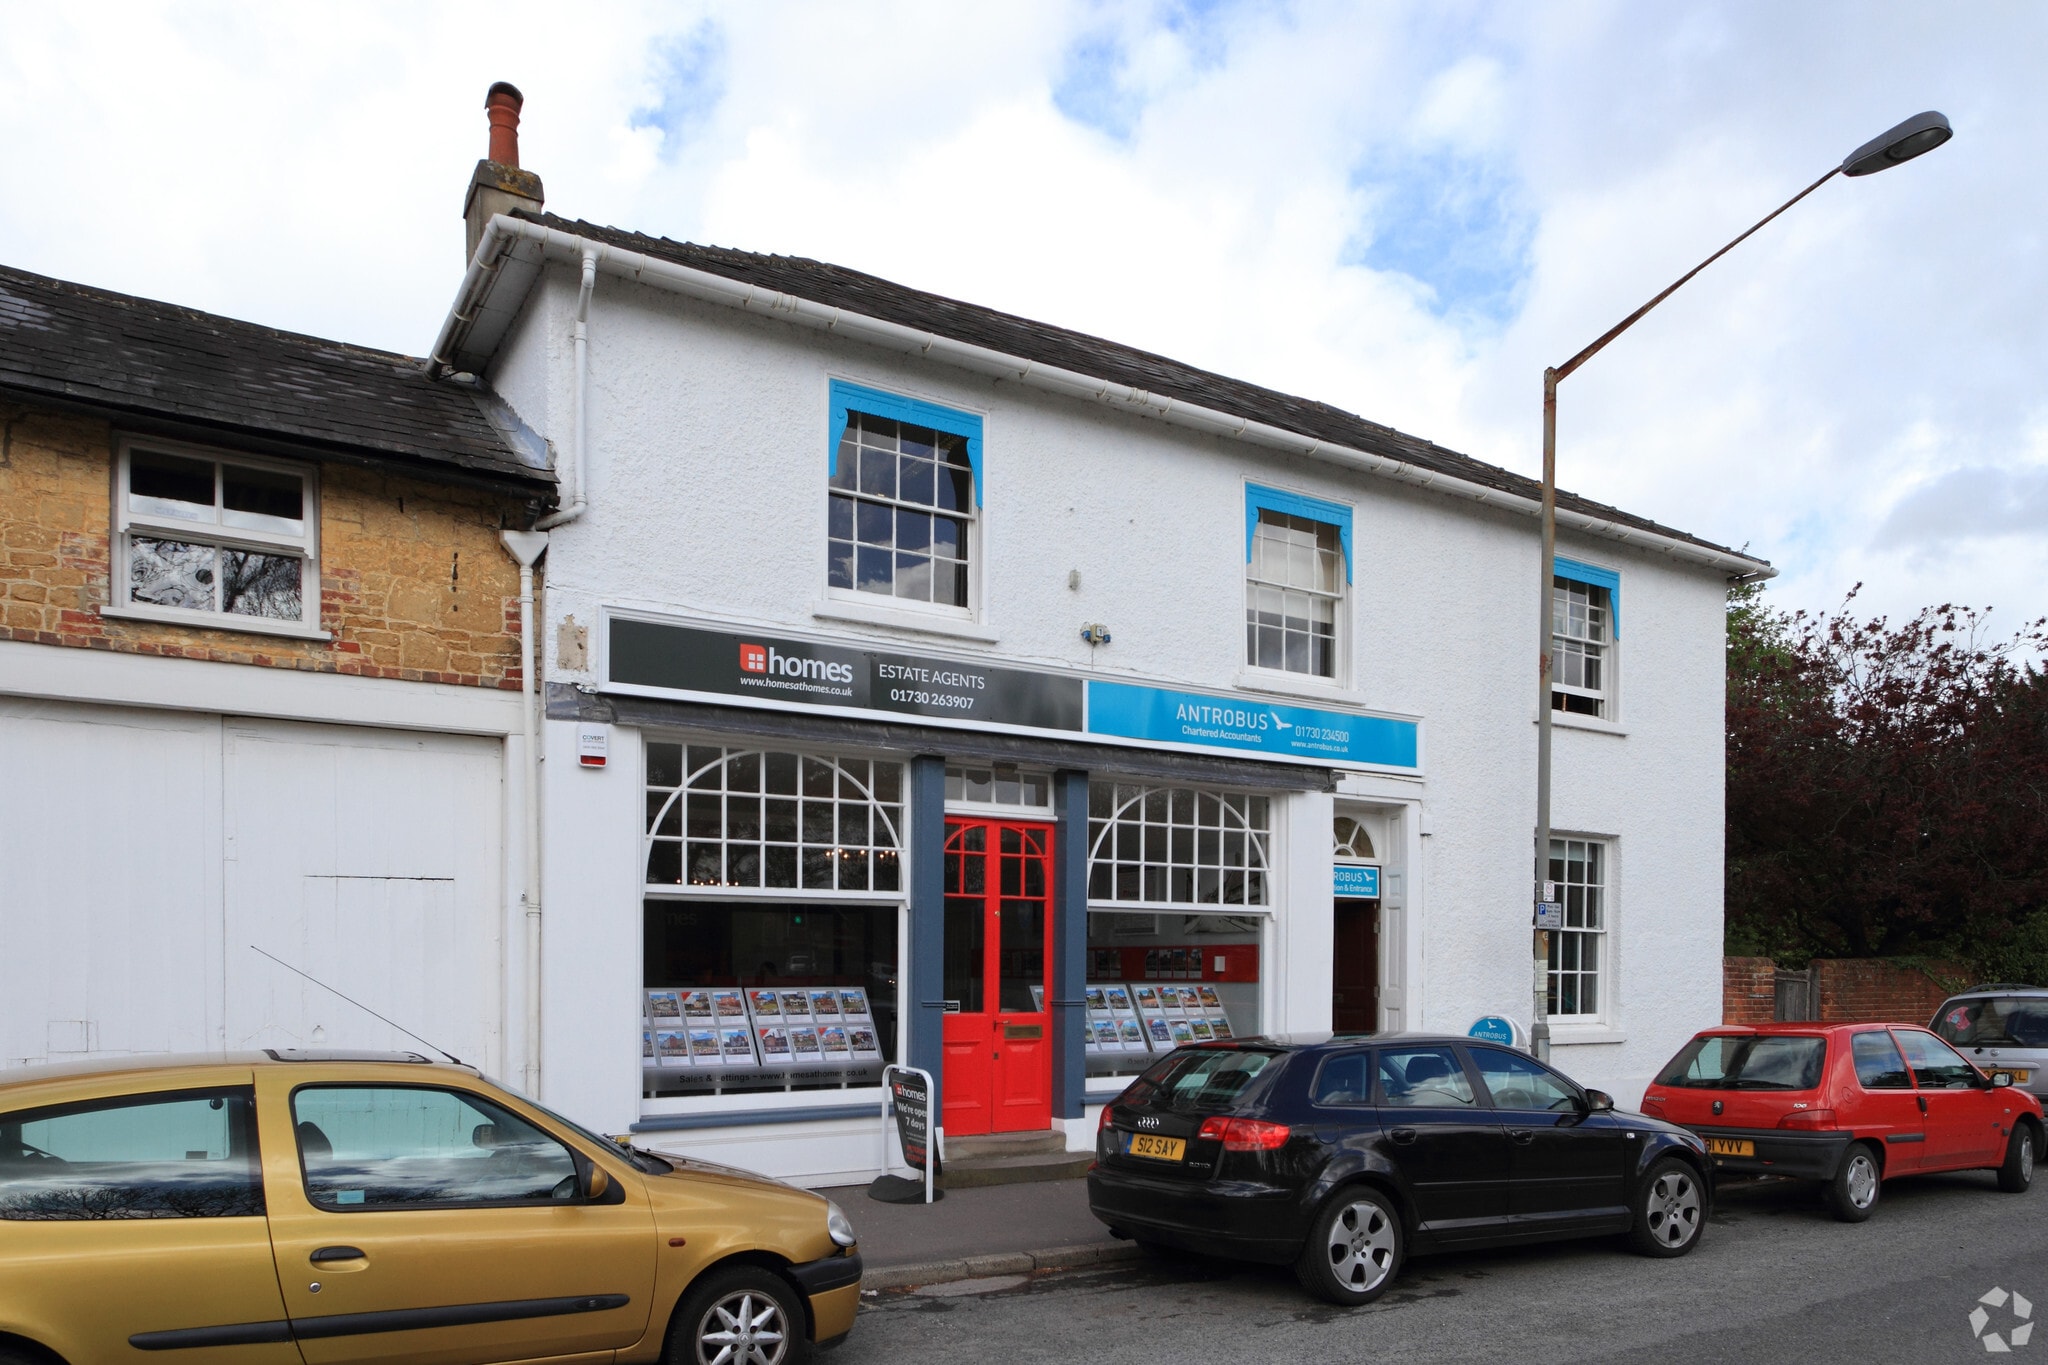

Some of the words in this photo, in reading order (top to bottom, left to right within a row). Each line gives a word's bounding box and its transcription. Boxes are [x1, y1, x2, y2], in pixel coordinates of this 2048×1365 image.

[769, 647, 853, 683] homes
[879, 664, 929, 683] ESTATE
[931, 671, 985, 690] AGENTS
[740, 677, 853, 697] www.homesathomes.co.uk
[890, 688, 929, 704] 01730
[931, 693, 974, 710] 263907
[1176, 703, 1268, 731] ANTROBUS
[1182, 725, 1219, 738] Chartered
[1220, 730, 1262, 743] Accountants
[1295, 726, 1320, 740] 01730
[1322, 729, 1350, 743] 234500
[1291, 740, 1349, 753] www.antrobus.co.uk
[1473, 1031, 1507, 1040] ANTROBUS
[705, 1074, 712, 1082] &
[715, 1073, 750, 1083] ettings
[902, 1085, 926, 1102] homes
[897, 1101, 914, 1114] We're
[905, 1116, 910, 1126] 7
[910, 1118, 925, 1130] days
[1137, 1136, 1152, 1153] S12
[1154, 1139, 1178, 1157] SAY
[1718, 1140, 1743, 1153] YVV
